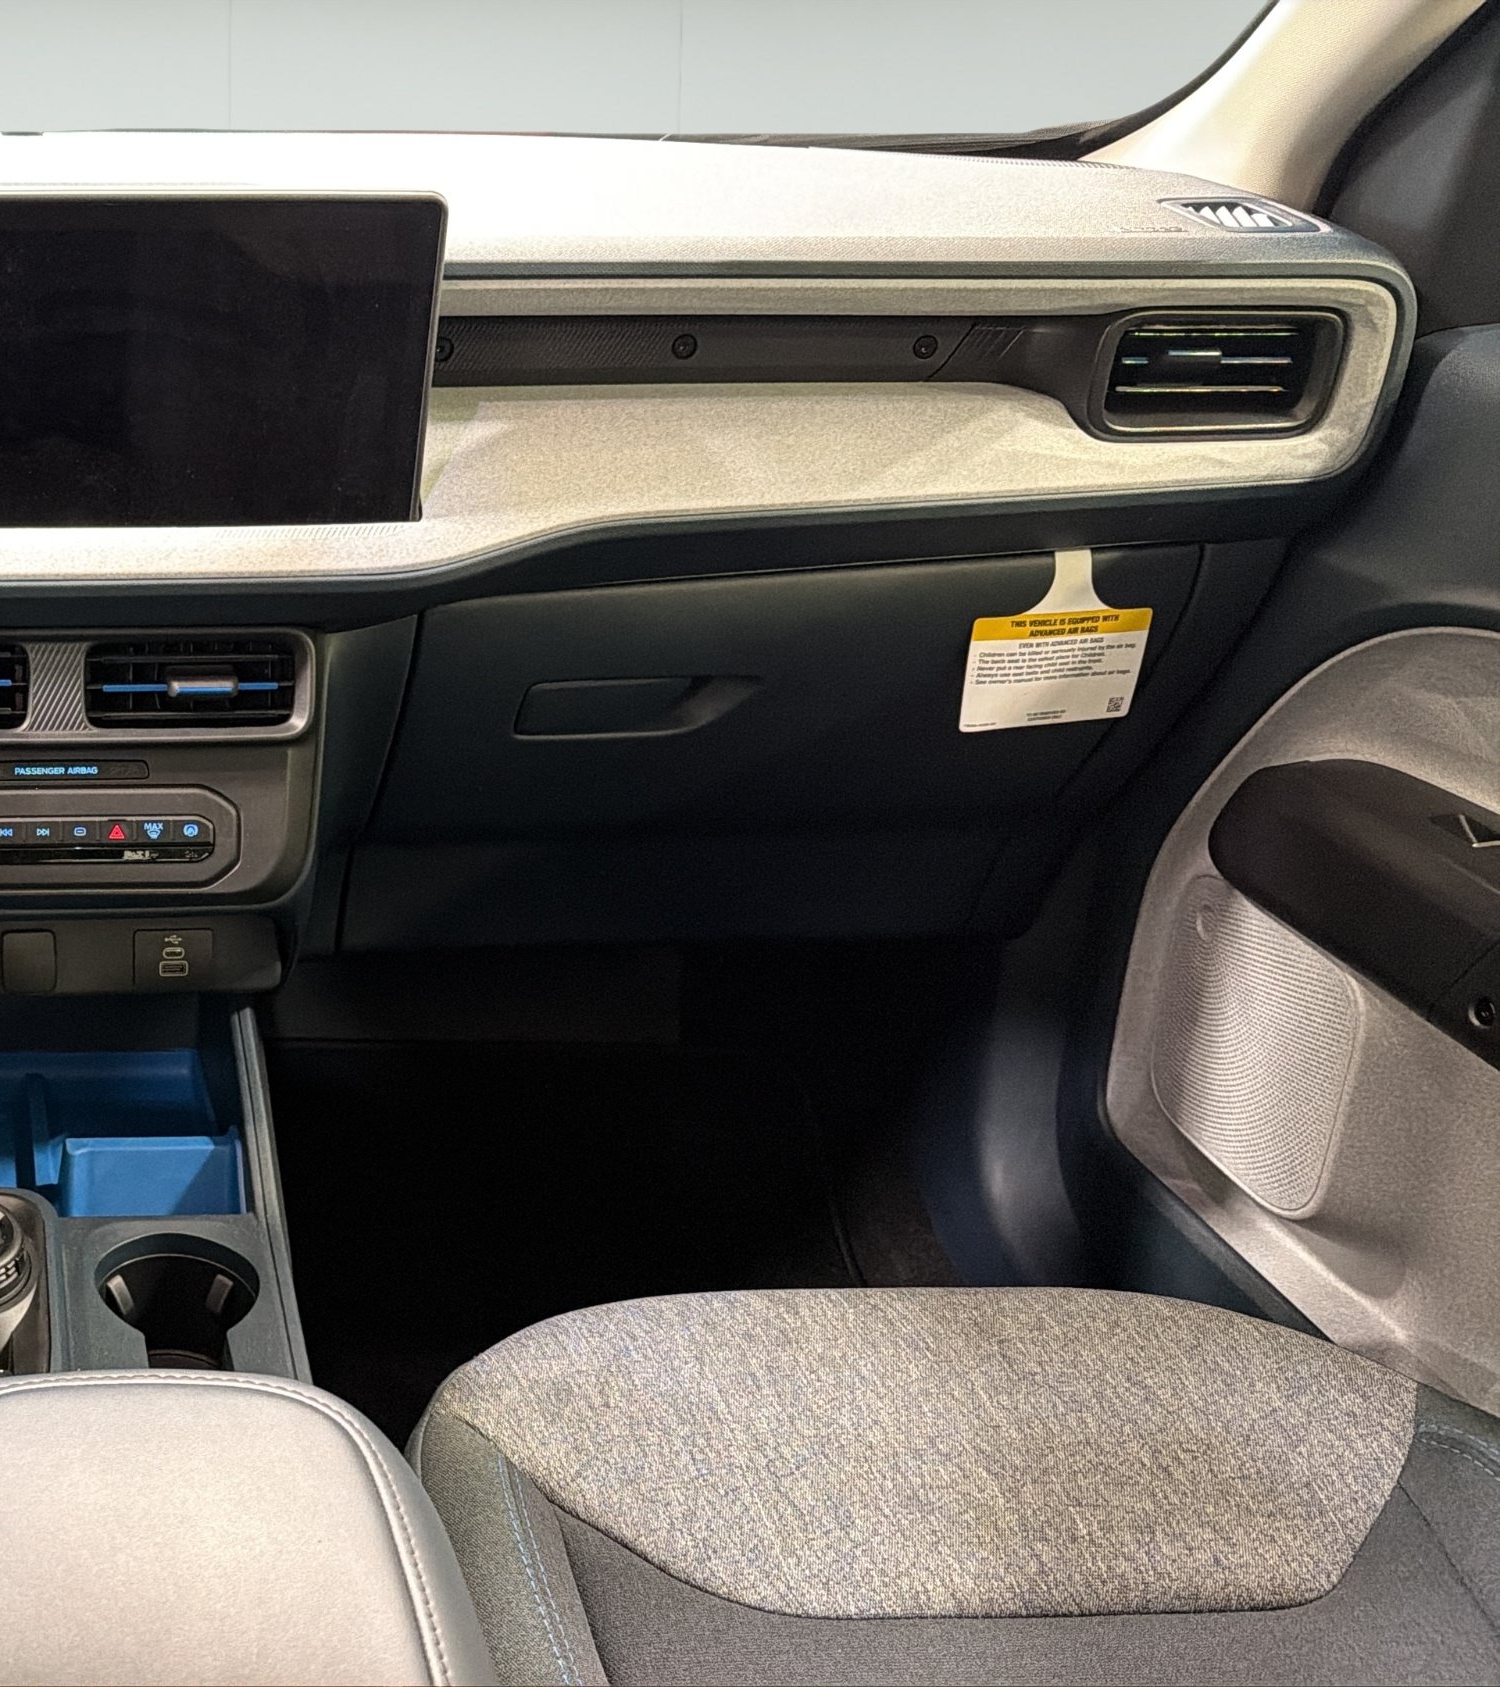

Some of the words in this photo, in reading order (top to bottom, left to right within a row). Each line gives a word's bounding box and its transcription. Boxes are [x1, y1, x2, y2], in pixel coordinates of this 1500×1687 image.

[1011, 620, 1027, 628] THIS
[1028, 619, 1058, 627] VEHICLE
[1067, 615, 1100, 625] EQUIPPED
[1102, 614, 1119, 622] WITH
[1028, 628, 1066, 637] ADVANCED
[1080, 625, 1099, 633] BAGS
[14, 767, 65, 776] PASSENGER
[67, 766, 98, 775] AIRBAG
[143, 823, 164, 831] MAX
